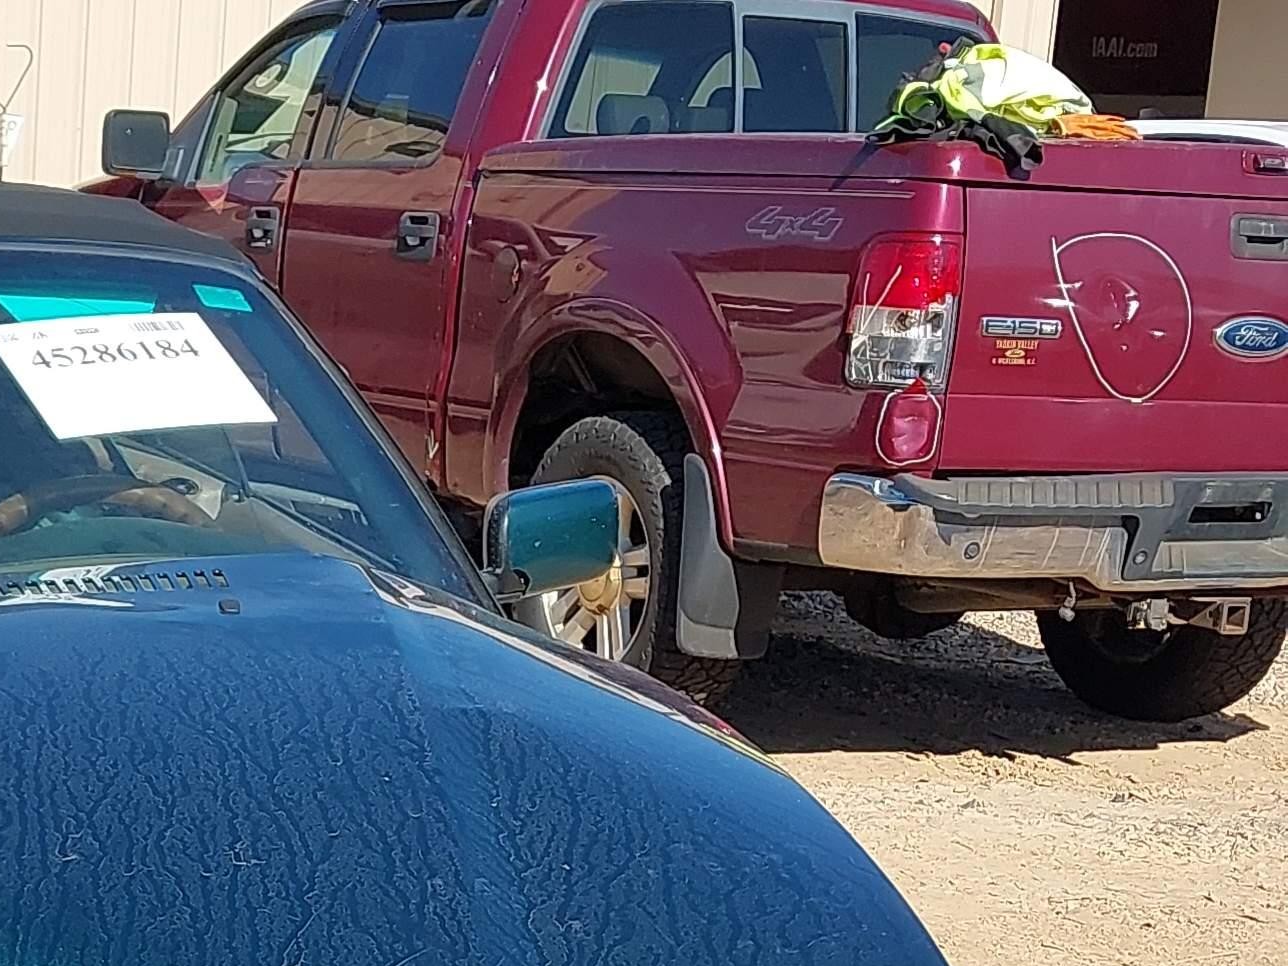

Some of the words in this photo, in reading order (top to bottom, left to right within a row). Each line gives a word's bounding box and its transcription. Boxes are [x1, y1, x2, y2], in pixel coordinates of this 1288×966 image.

[1092, 36, 1158, 58] IAAI.com
[744, 205, 844, 240] 4x4
[1231, 325, 1279, 348] Ford
[31, 338, 200, 369] 45286184
